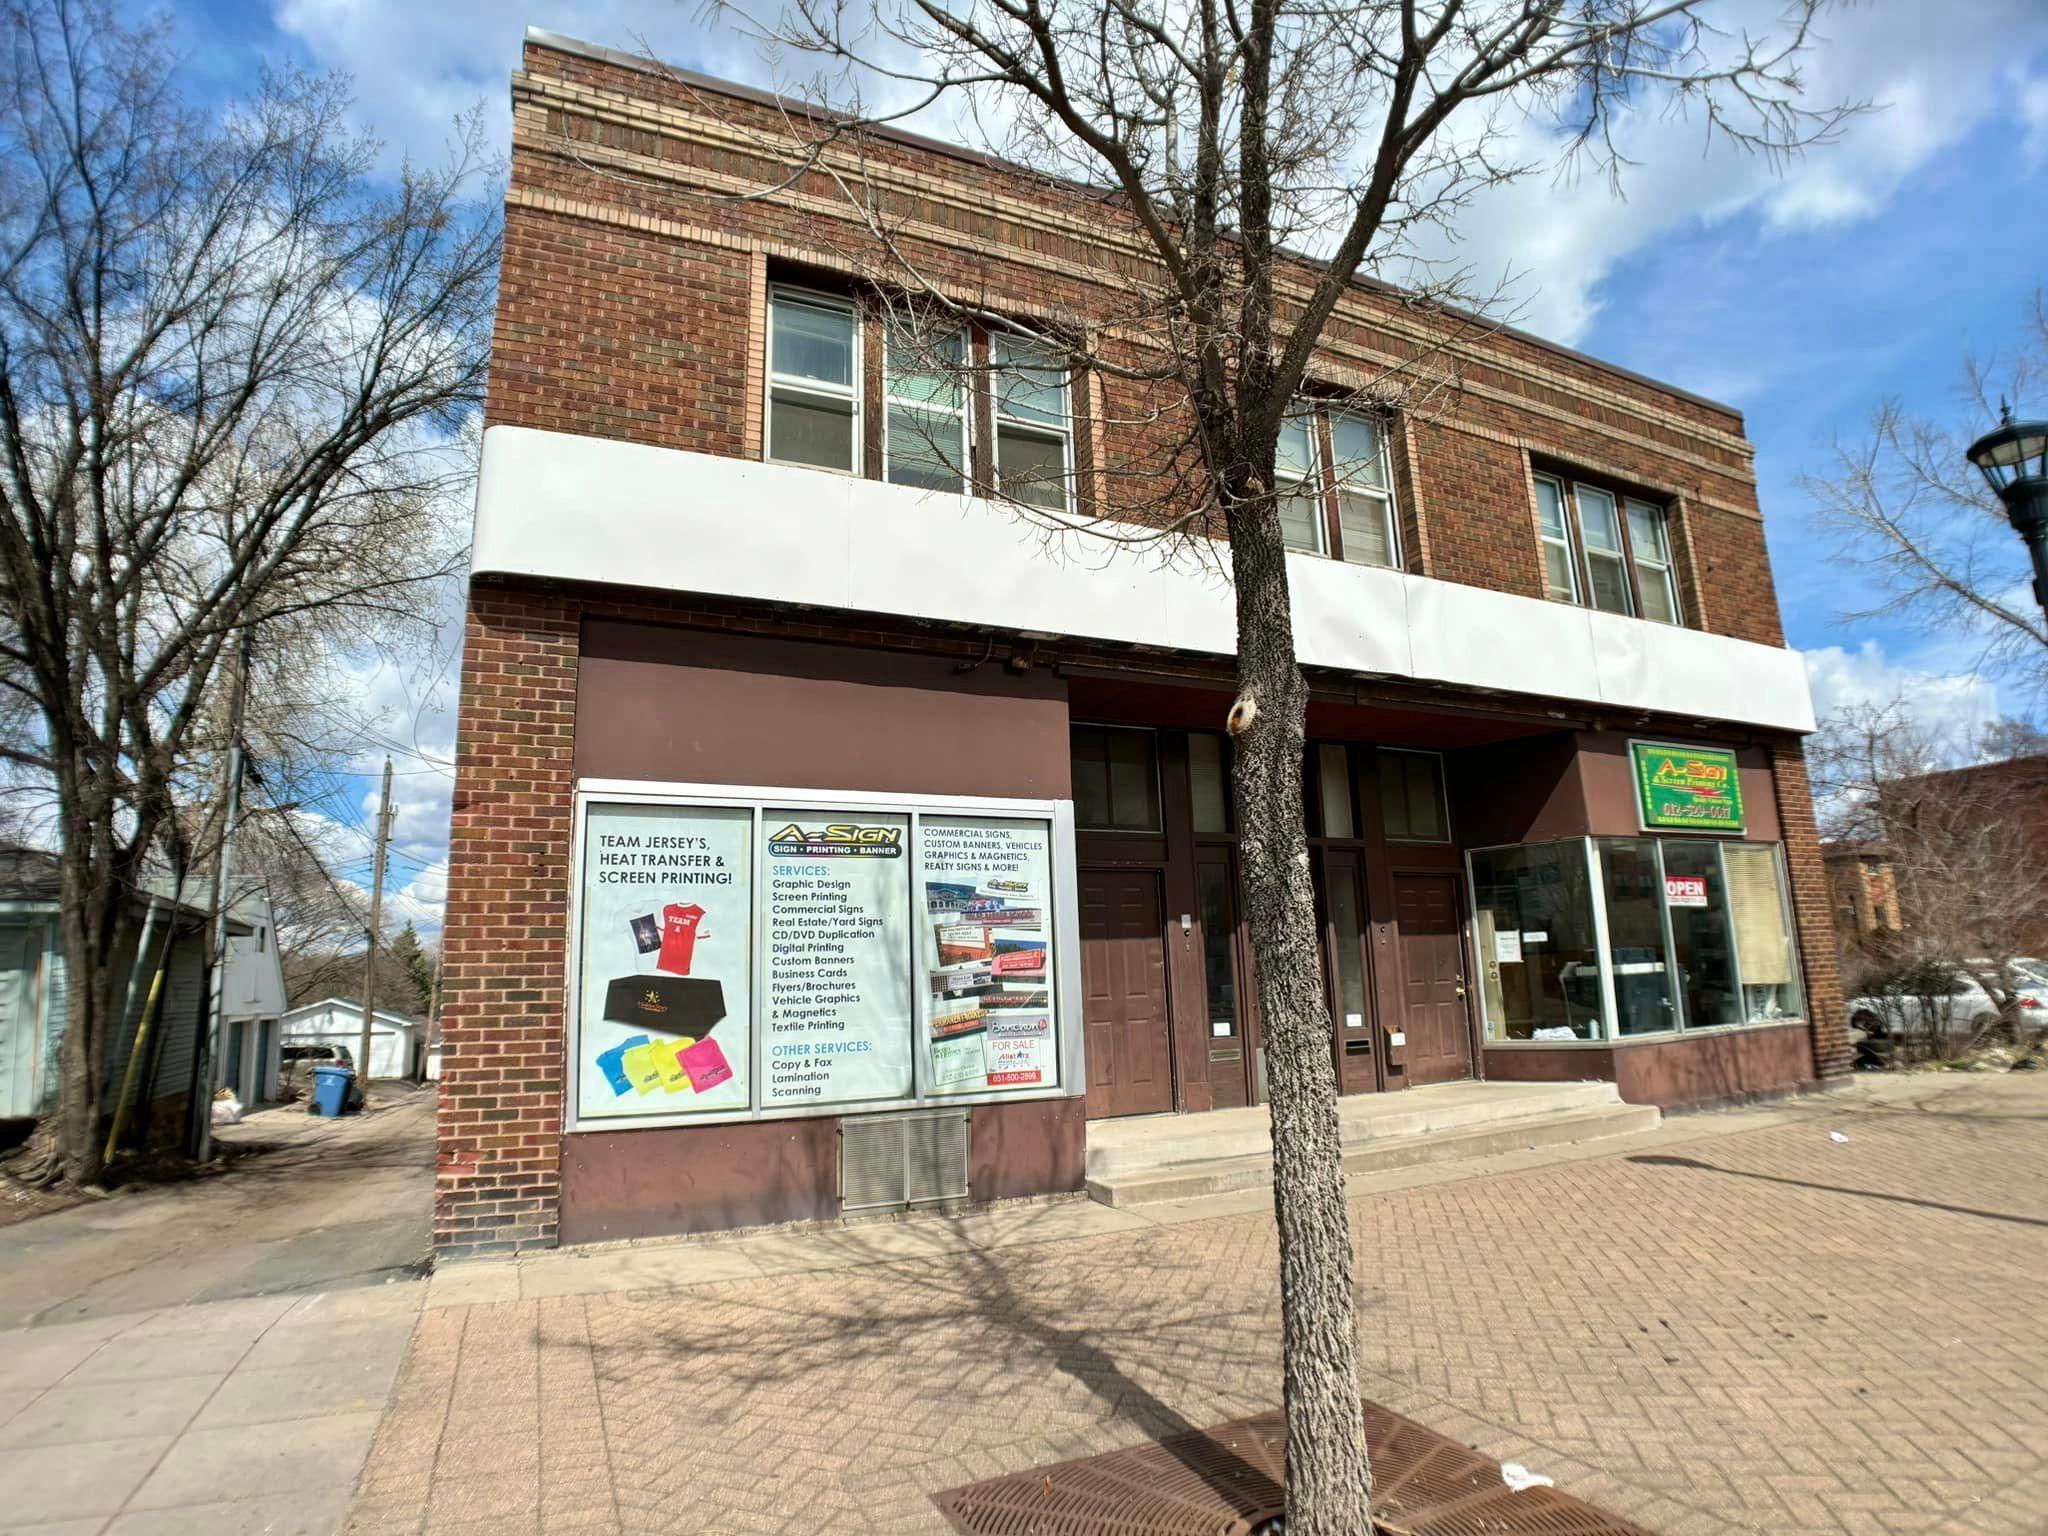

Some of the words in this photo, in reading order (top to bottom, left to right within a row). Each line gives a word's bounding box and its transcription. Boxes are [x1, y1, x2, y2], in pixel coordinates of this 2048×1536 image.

[769, 824, 901, 844] A-SIGN
[924, 829, 983, 838] COMMERCIAL
[600, 835, 641, 848] TEAM
[645, 836, 711, 851] JERSEY'S,
[924, 840, 961, 849] CUSTOM
[1006, 842, 1042, 850] VEHICLES
[600, 853, 637, 866] HEAT
[642, 854, 710, 867] TRANSFER
[716, 856, 724, 867] &
[925, 851, 968, 860] GRAPHICS
[773, 865, 830, 876] SERVICES:
[925, 862, 954, 870] REALTY
[957, 863, 982, 871] SIGNS
[993, 863, 1018, 871] MORE!
[599, 872, 656, 883] SCREEN
[662, 872, 731, 885] PRINTING!
[773, 880, 814, 890] Graphic
[818, 880, 850, 890] Design
[1667, 881, 1704, 896] OPEN
[772, 893, 808, 901] Screen
[811, 893, 847, 903] Printing
[773, 905, 836, 914] Commercial
[839, 905, 863, 915] Signs
[773, 918, 794, 927] Real
[798, 917, 856, 927] Estate/Yard
[859, 918, 883, 927] Signs
[773, 930, 815, 941] CD/DVD
[819, 930, 875, 940] Duplication
[772, 943, 805, 954] Digital
[808, 943, 844, 953] Printing
[772, 957, 811, 965] Custom
[815, 956, 854, 965] Banners
[773, 970, 814, 979] Business
[818, 969, 847, 977] Cards
[773, 981, 856, 993] Flyers/Brochures
[773, 996, 811, 1005] Vehicle
[815, 994, 860, 1005] Graphics
[773, 1010, 778, 1019] &
[783, 1008, 836, 1020] Magnetics
[772, 1022, 804, 1032] Textile
[808, 1021, 845, 1031] Printing
[772, 1045, 810, 1056] OTHER
[815, 1041, 872, 1054] SERVICES:
[993, 1041, 1011, 1050] FOR
[1013, 1040, 1035, 1049] SALE
[772, 1061, 801, 1070] Copy
[814, 1058, 832, 1066] Fax
[773, 1071, 829, 1083] Lamination
[772, 1086, 821, 1097] Scanning
